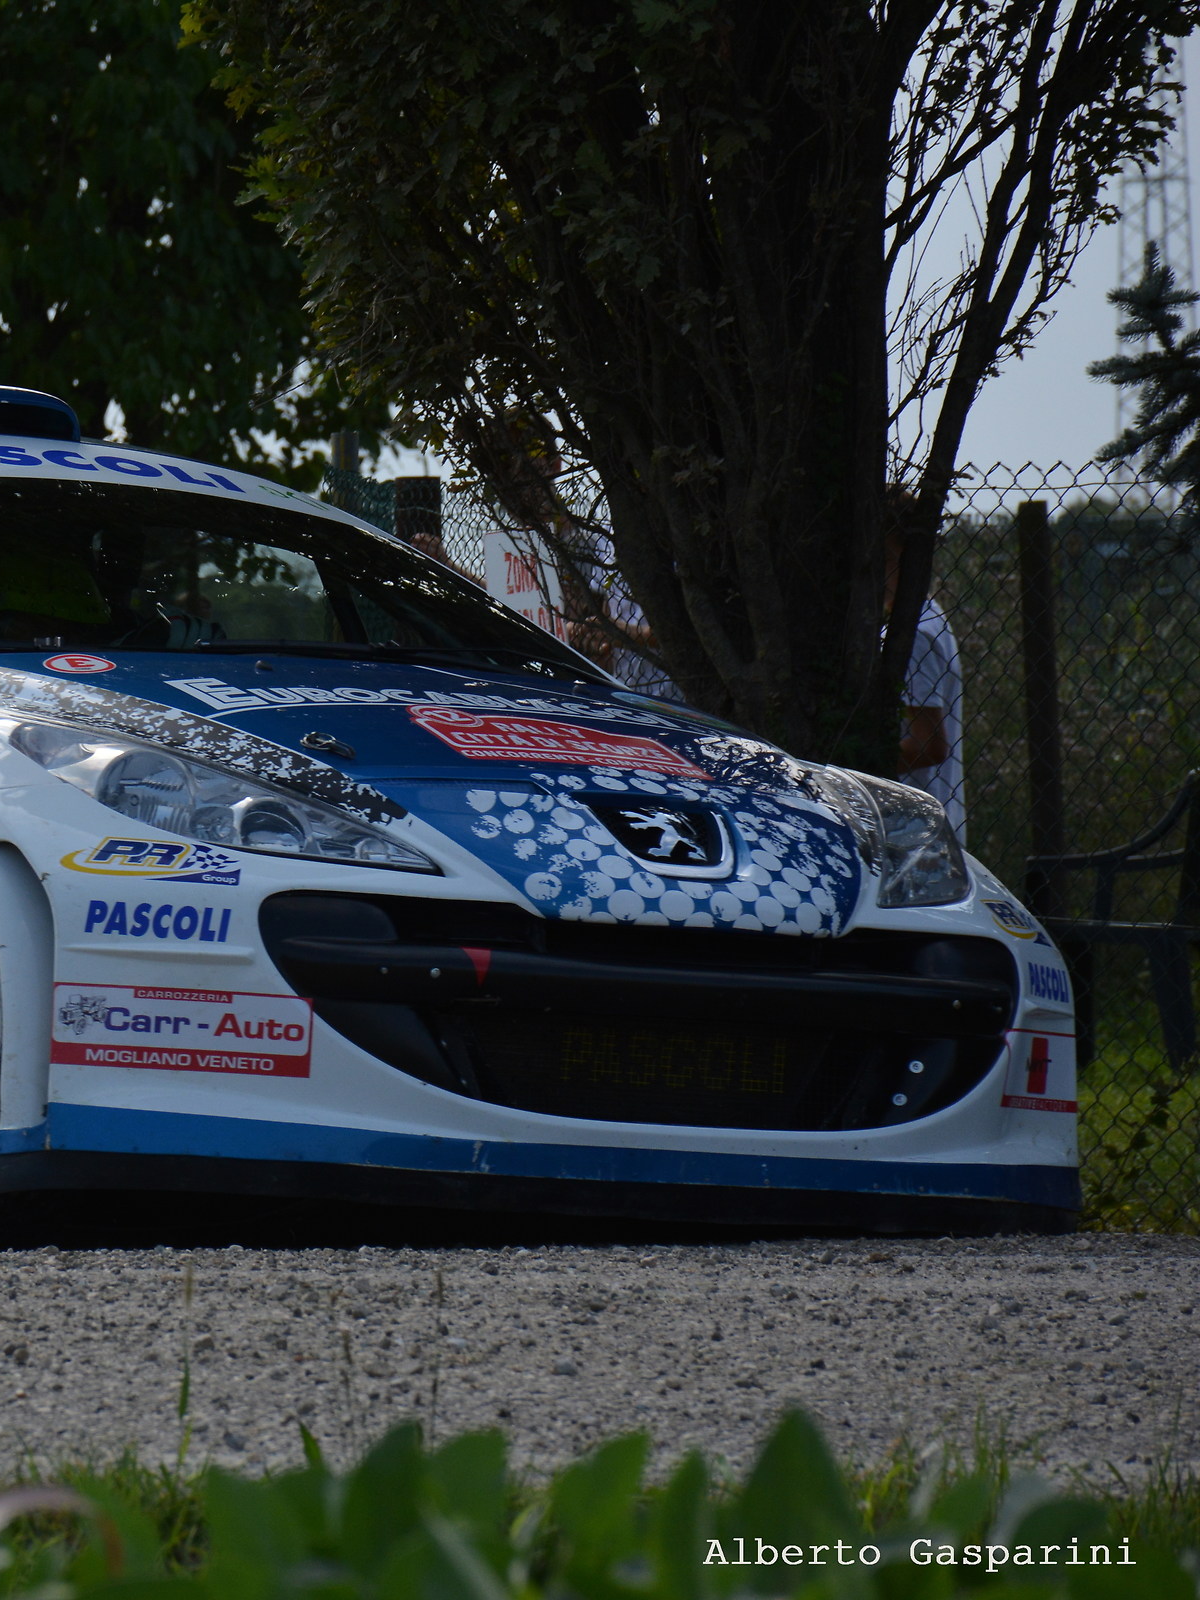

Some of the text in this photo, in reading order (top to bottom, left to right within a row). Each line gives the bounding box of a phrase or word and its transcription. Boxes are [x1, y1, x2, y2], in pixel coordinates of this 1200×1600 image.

[490, 722, 586, 738] RALLY
[530, 735, 567, 749] DI
[93, 839, 184, 866] PR
[202, 874, 236, 885] Group
[84, 900, 231, 942] PASCOLI
[1028, 962, 1070, 1003] PASCOLI
[137, 989, 229, 1002] CARROZZERIA
[85, 1049, 275, 1071] MOGLIANO VENETO
